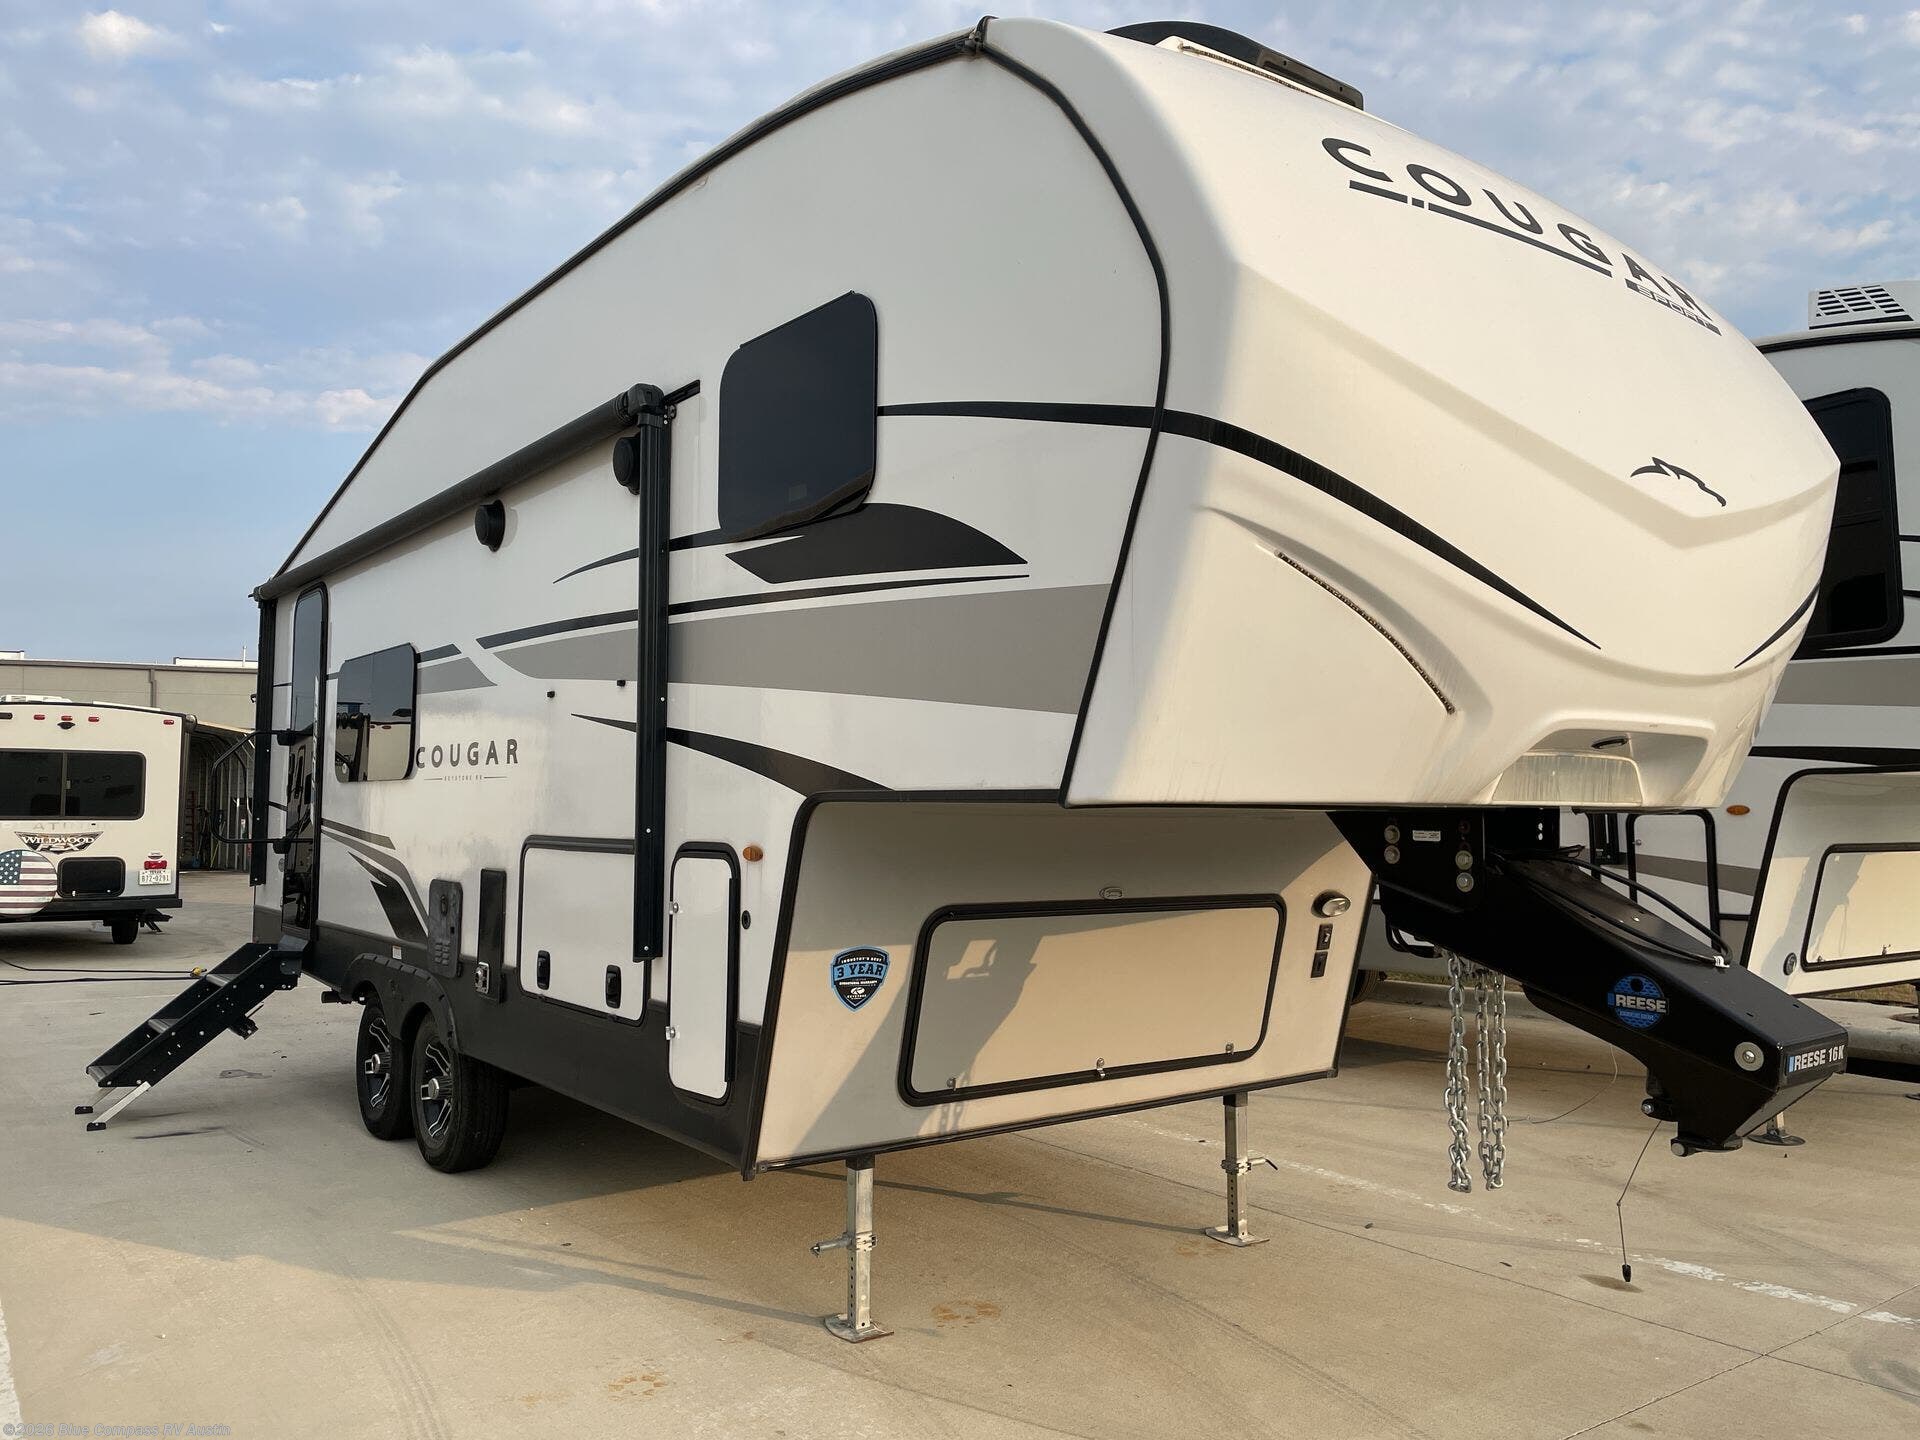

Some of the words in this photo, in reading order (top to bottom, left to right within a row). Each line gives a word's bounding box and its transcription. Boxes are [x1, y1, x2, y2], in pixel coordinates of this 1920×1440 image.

[1321, 137, 1713, 321] COUGAR
[1636, 283, 1707, 327] SPORT
[416, 738, 518, 769] COUGAR
[21, 836, 95, 844] WILDWOOD
[837, 967, 845, 978] 3
[849, 963, 884, 976] YEAR
[1615, 994, 1667, 1014] REESE
[1794, 1048, 1827, 1072] REESE
[1828, 1044, 1845, 1062] 16K
